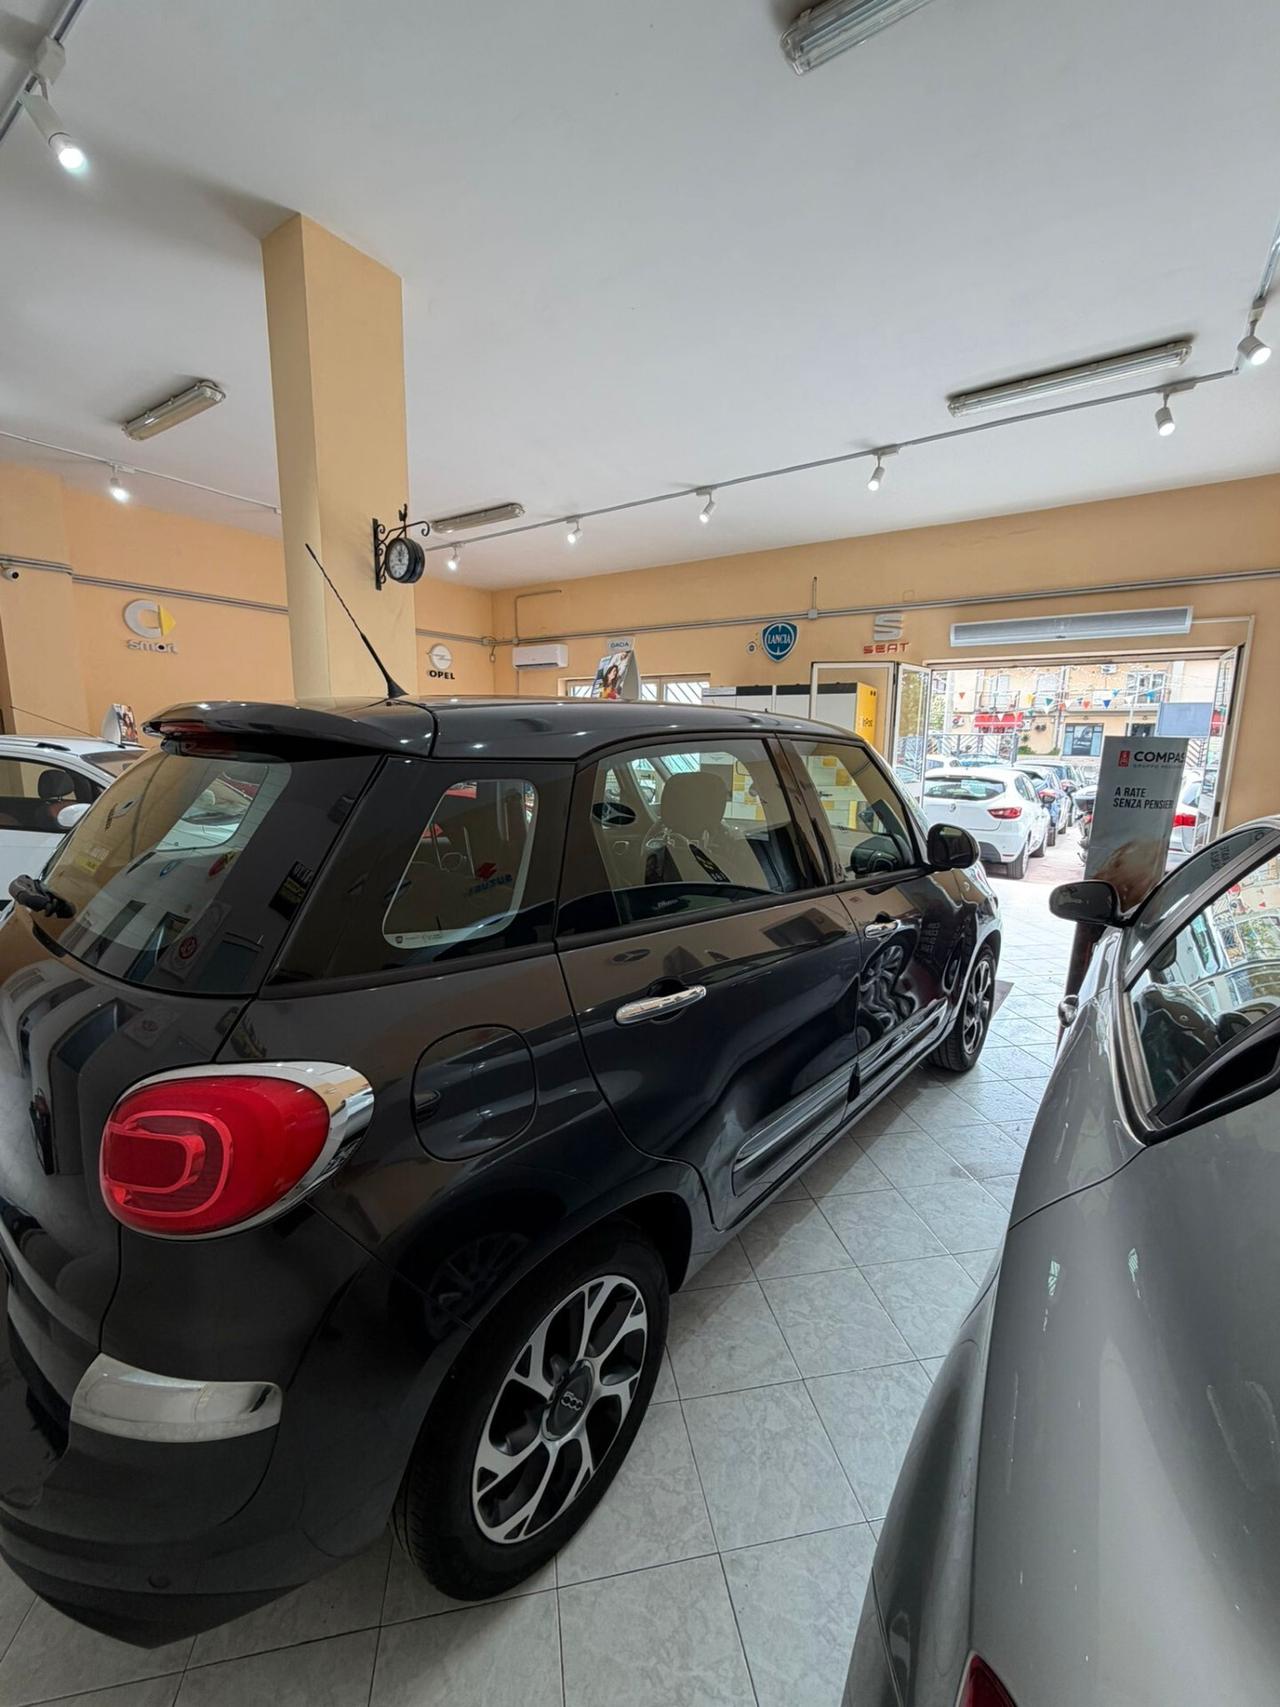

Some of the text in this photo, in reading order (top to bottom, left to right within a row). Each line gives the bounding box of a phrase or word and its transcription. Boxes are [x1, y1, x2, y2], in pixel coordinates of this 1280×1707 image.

[767, 634, 791, 645] LANCIA
[863, 642, 909, 655] SEAT
[429, 670, 456, 680] OPEL
[1114, 787, 1147, 798] A RATE
[1113, 798, 1142, 809] SENZA
[560, 1390, 584, 1411] 500
